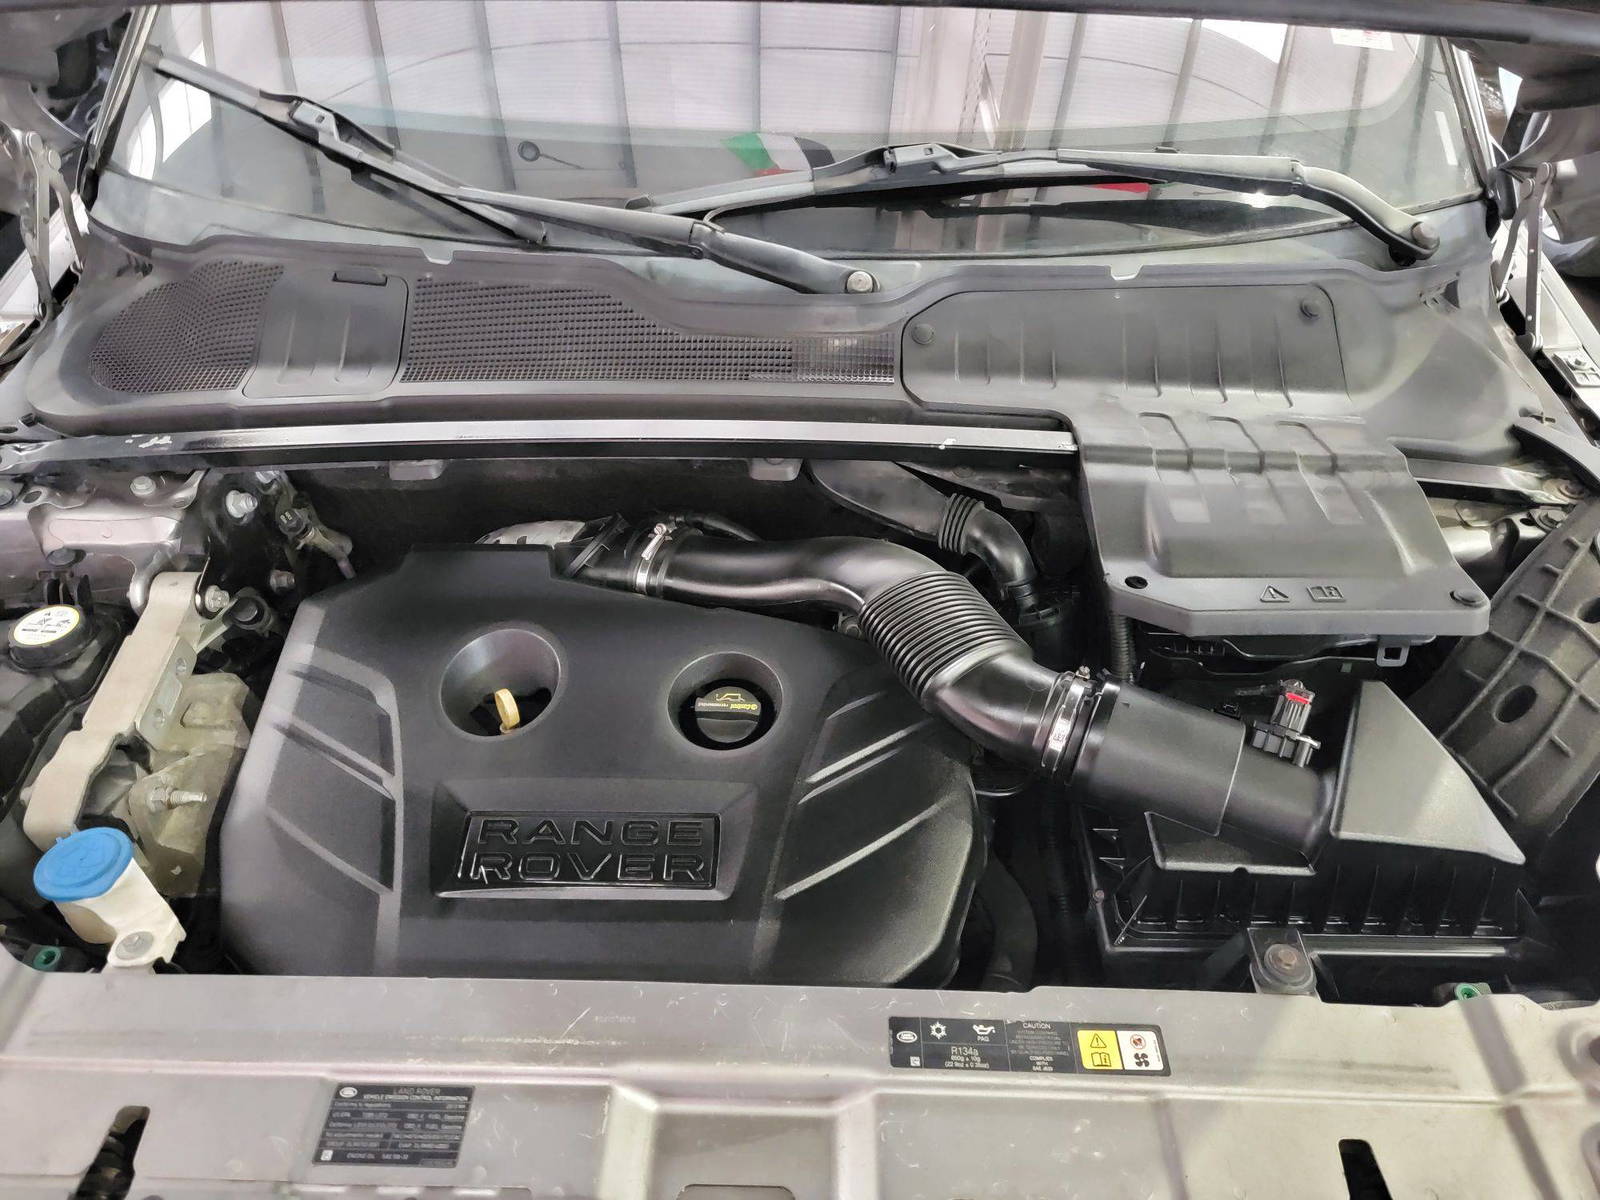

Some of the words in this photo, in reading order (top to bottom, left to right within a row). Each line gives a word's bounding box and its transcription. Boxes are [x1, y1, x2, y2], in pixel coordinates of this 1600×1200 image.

[477, 819, 704, 845] RANGE
[470, 853, 704, 881] ROVER
[951, 1046, 979, 1056] R134a
